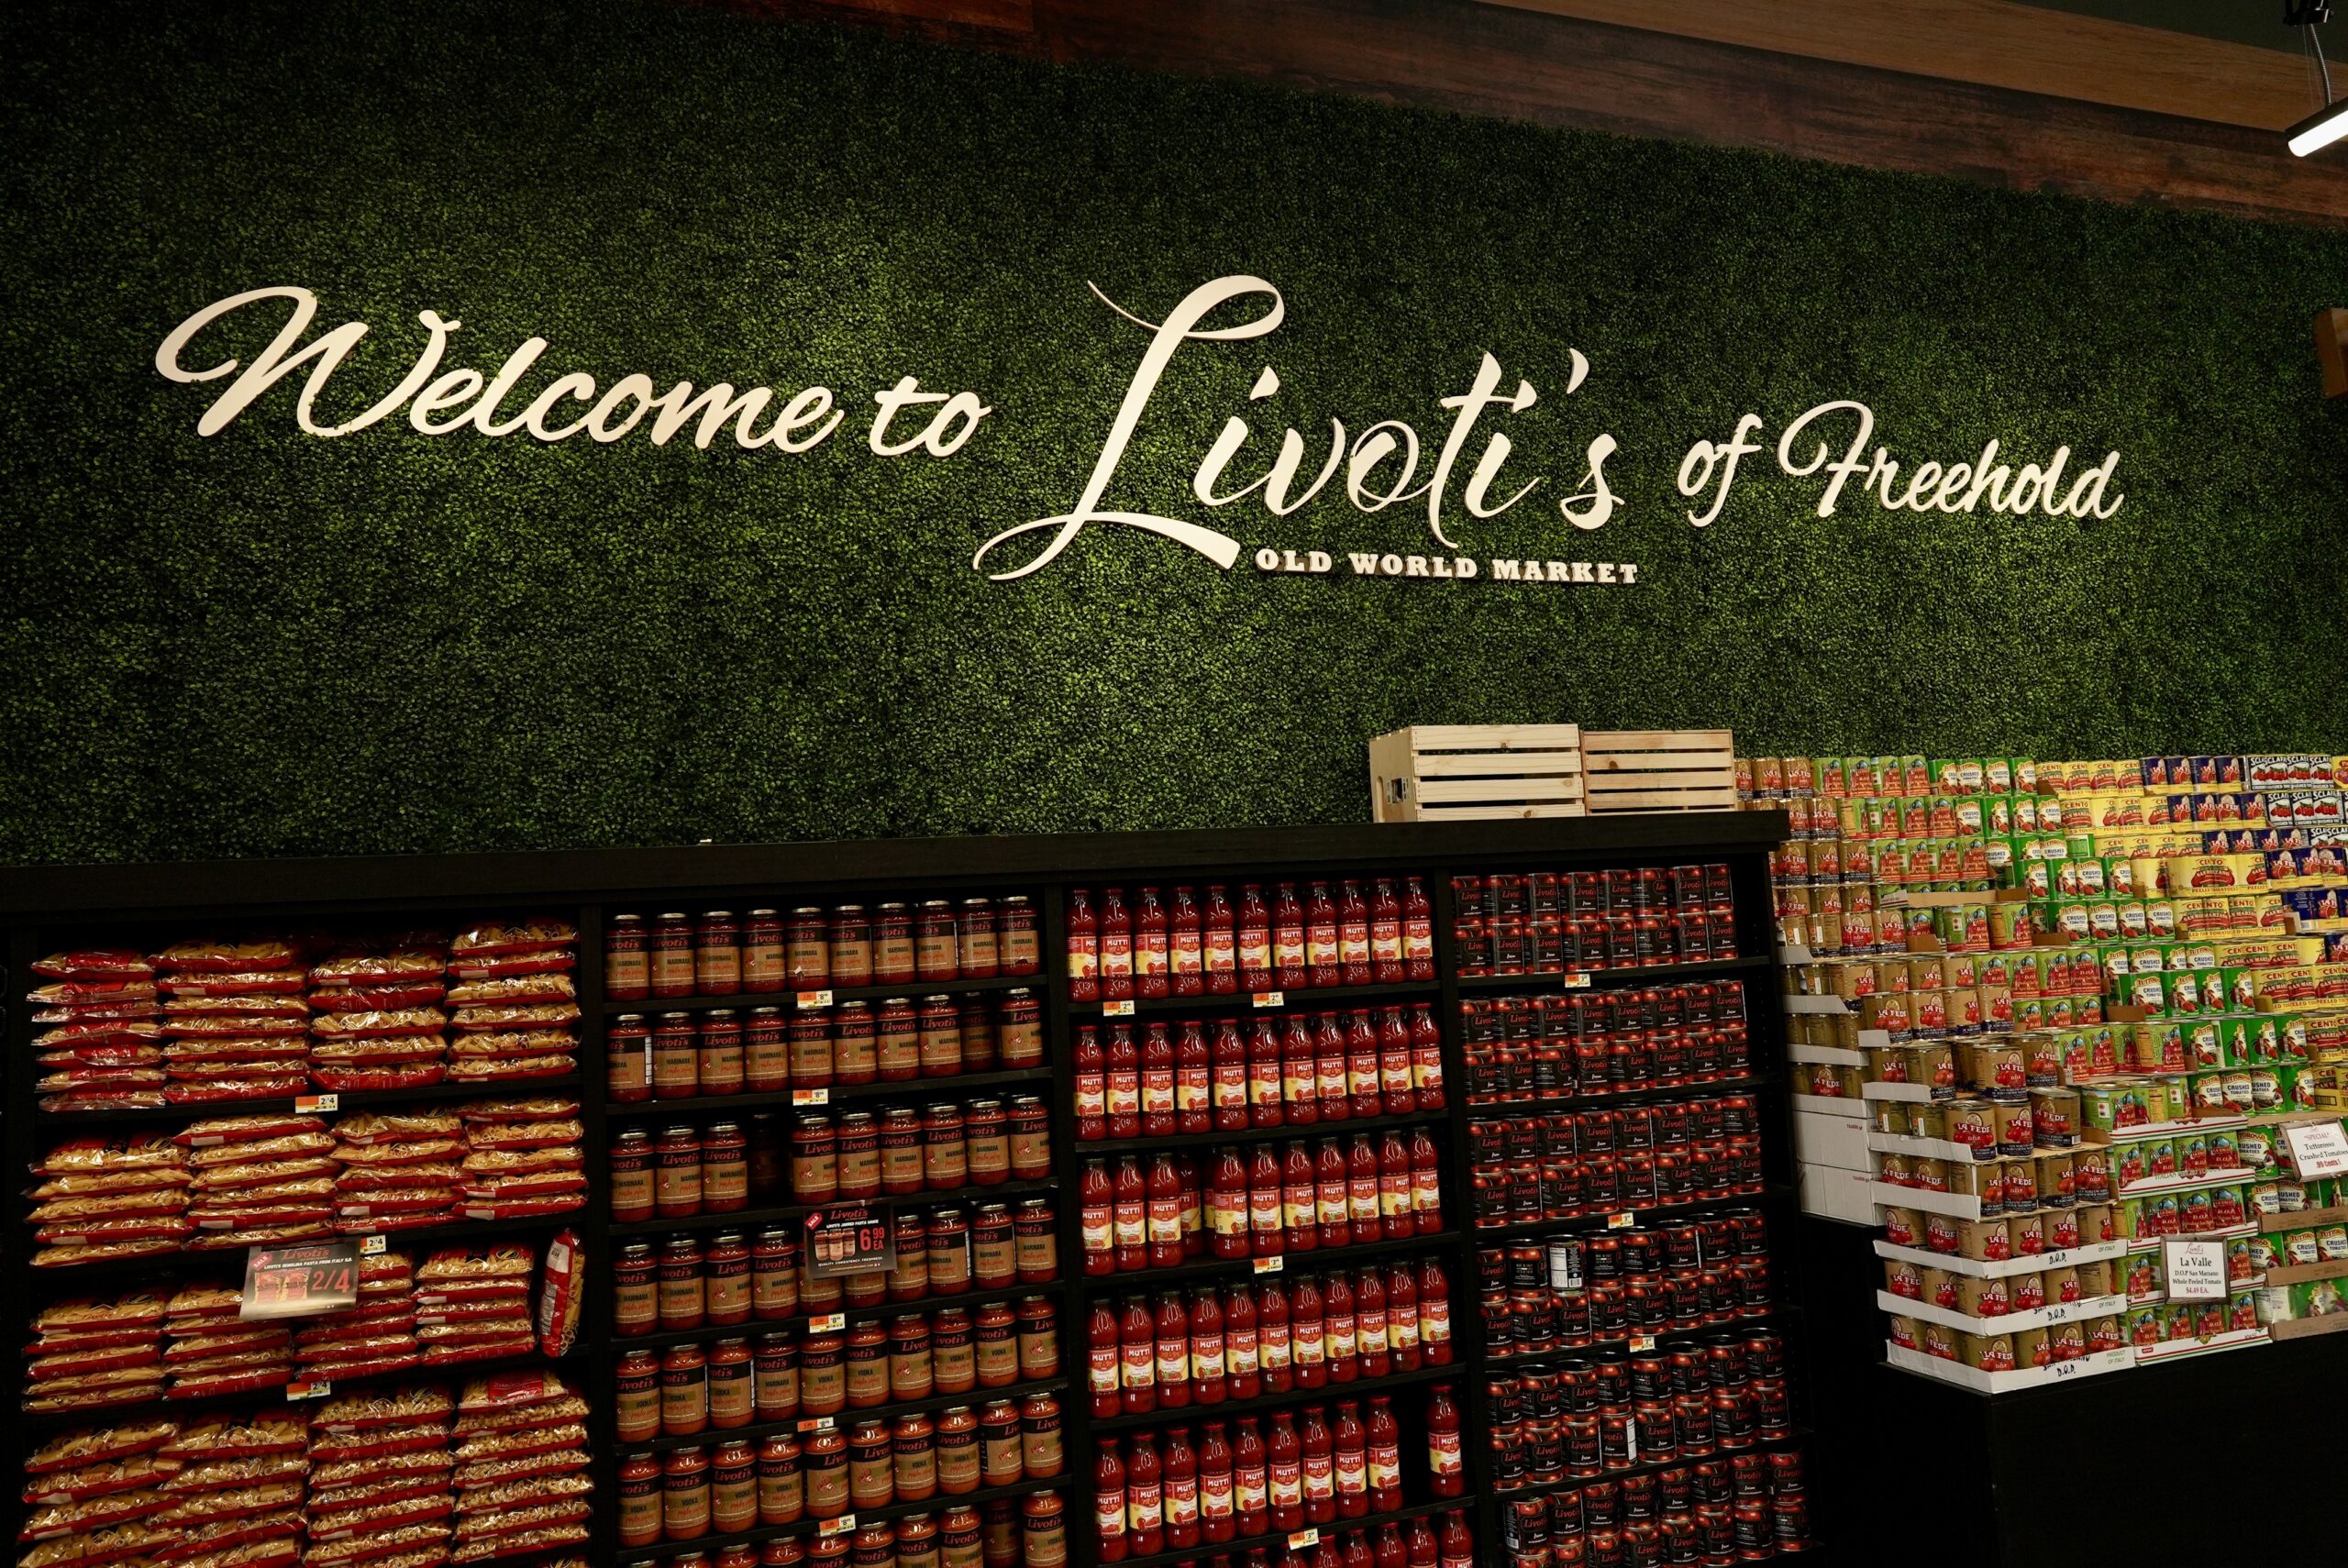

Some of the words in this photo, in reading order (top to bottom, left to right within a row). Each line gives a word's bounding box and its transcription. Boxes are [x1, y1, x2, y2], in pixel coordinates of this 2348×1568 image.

[156, 286, 845, 453] Welcome
[869, 376, 991, 457] to
[973, 275, 1624, 580] Livoti's
[1678, 414, 1763, 529] of
[1778, 401, 2124, 519] Freehold
[1256, 547, 1333, 572] OLD
[1348, 552, 1478, 579] WORLD
[1492, 558, 1638, 584] MARKET
[1107, 938, 1128, 946] MUTTI
[1385, 1055, 1406, 1064] MUTTI
[1081, 1077, 1102, 1086] MUTTI
[1115, 1076, 1136, 1084] MUTTI
[2043, 1110, 2066, 1122] FEDE
[1957, 1122, 1967, 1132] LA
[1970, 1125, 1991, 1133] FEDE
[1921, 1176, 1944, 1186] FEDE
[2012, 1176, 2032, 1187] FEDE
[1253, 1194, 1275, 1202] MUTTI
[1154, 1203, 1176, 1211] MUTTI
[859, 1228, 871, 1252] 6
[2180, 1257, 2189, 1266] La
[2191, 1257, 2212, 1266] Valle
[312, 1268, 350, 1294] 2/4
[1364, 1316, 1384, 1324] MUTTI
[1128, 1348, 1150, 1356] MUTTI
[1091, 1353, 1114, 1361] MUTTI
[1308, 1461, 1329, 1469] MUTTI
[1276, 1467, 1298, 1476] MUTTI
[1097, 1496, 1120, 1504] MUTTI
